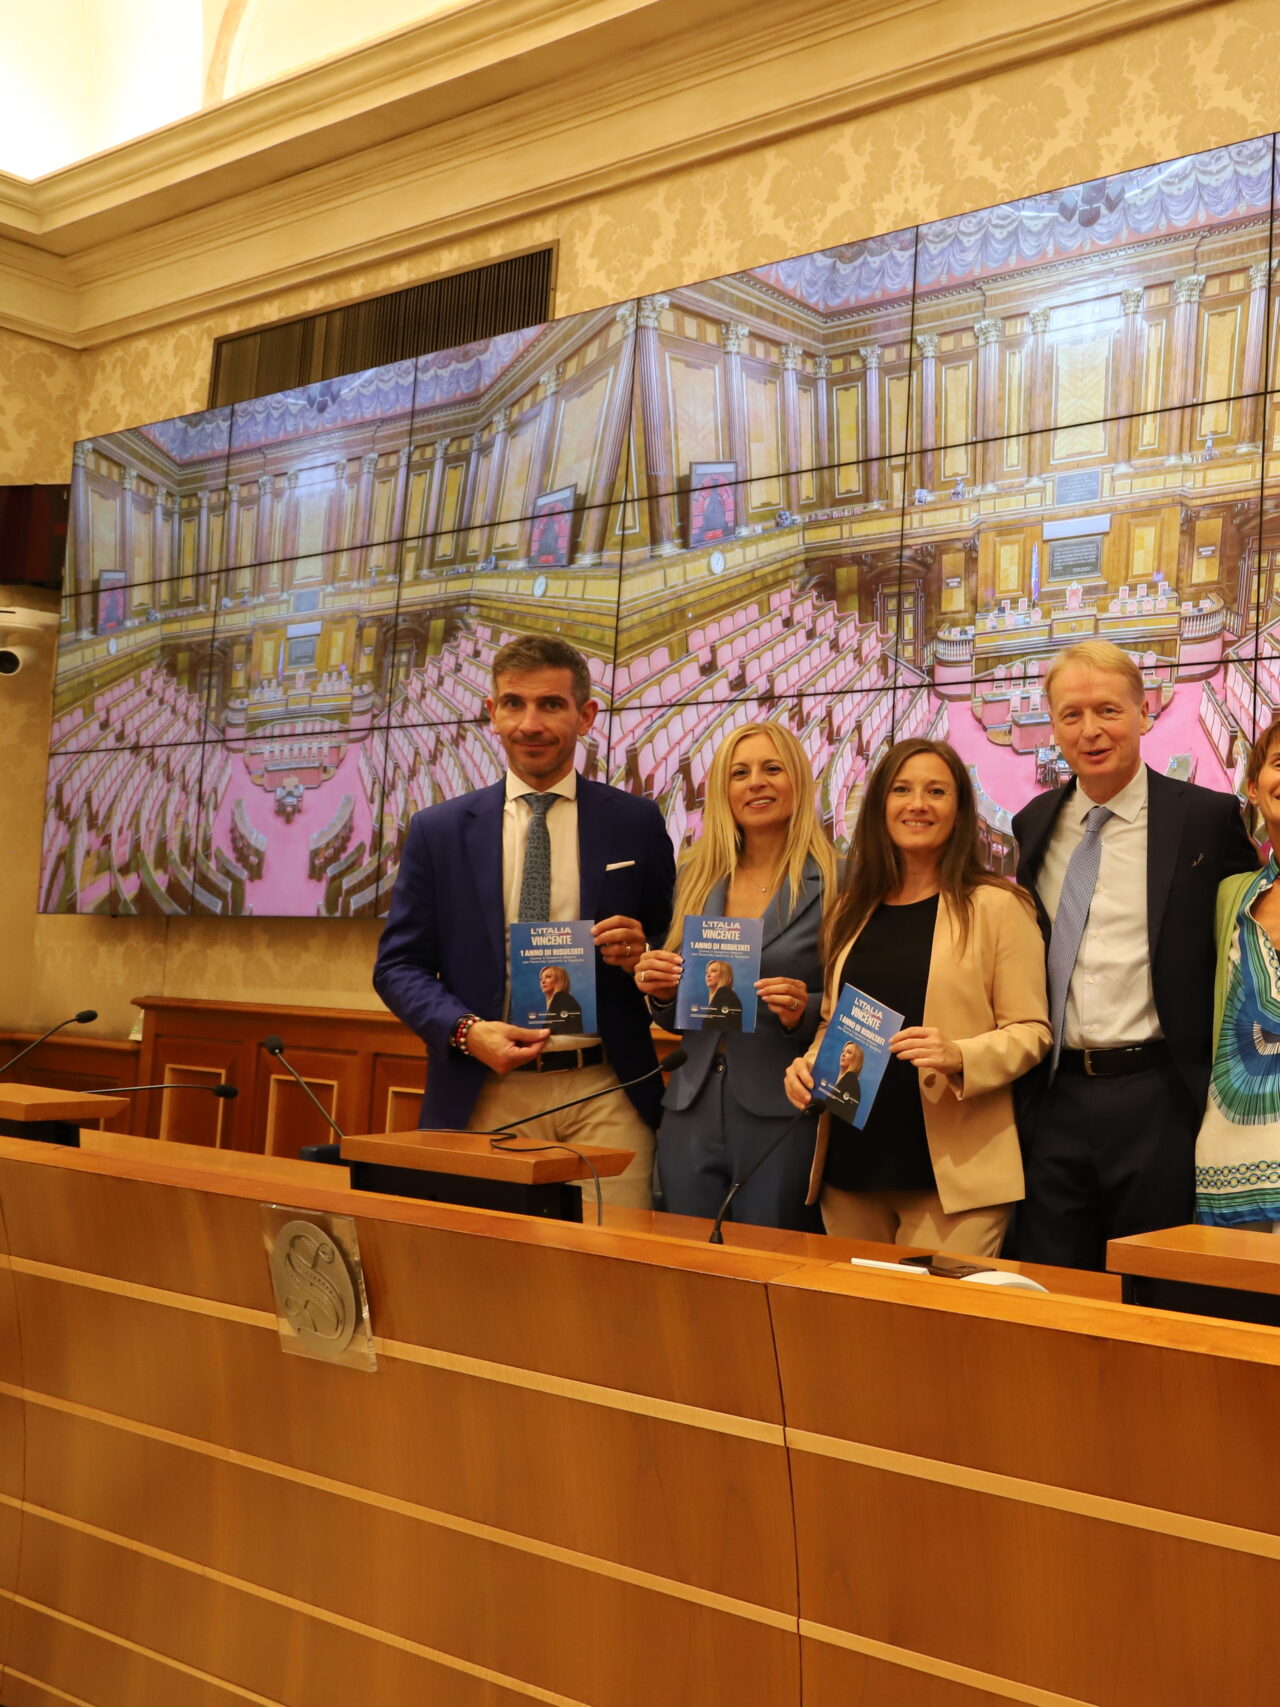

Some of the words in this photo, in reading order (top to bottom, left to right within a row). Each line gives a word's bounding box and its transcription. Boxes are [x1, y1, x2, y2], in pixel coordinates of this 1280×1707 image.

[702, 921, 741, 929] L'ITALIA
[531, 927, 572, 935] L'ITALIA
[702, 929, 741, 941] VINCENTE
[531, 935, 573, 946] VINCENTE
[524, 949, 544, 957] ANNO
[552, 947, 584, 956] RISULTATI
[712, 942, 720, 950] DI
[720, 943, 751, 952] RISULTATI
[854, 997, 883, 1020] L'ITALIA
[851, 1004, 881, 1031] VINCENTE
